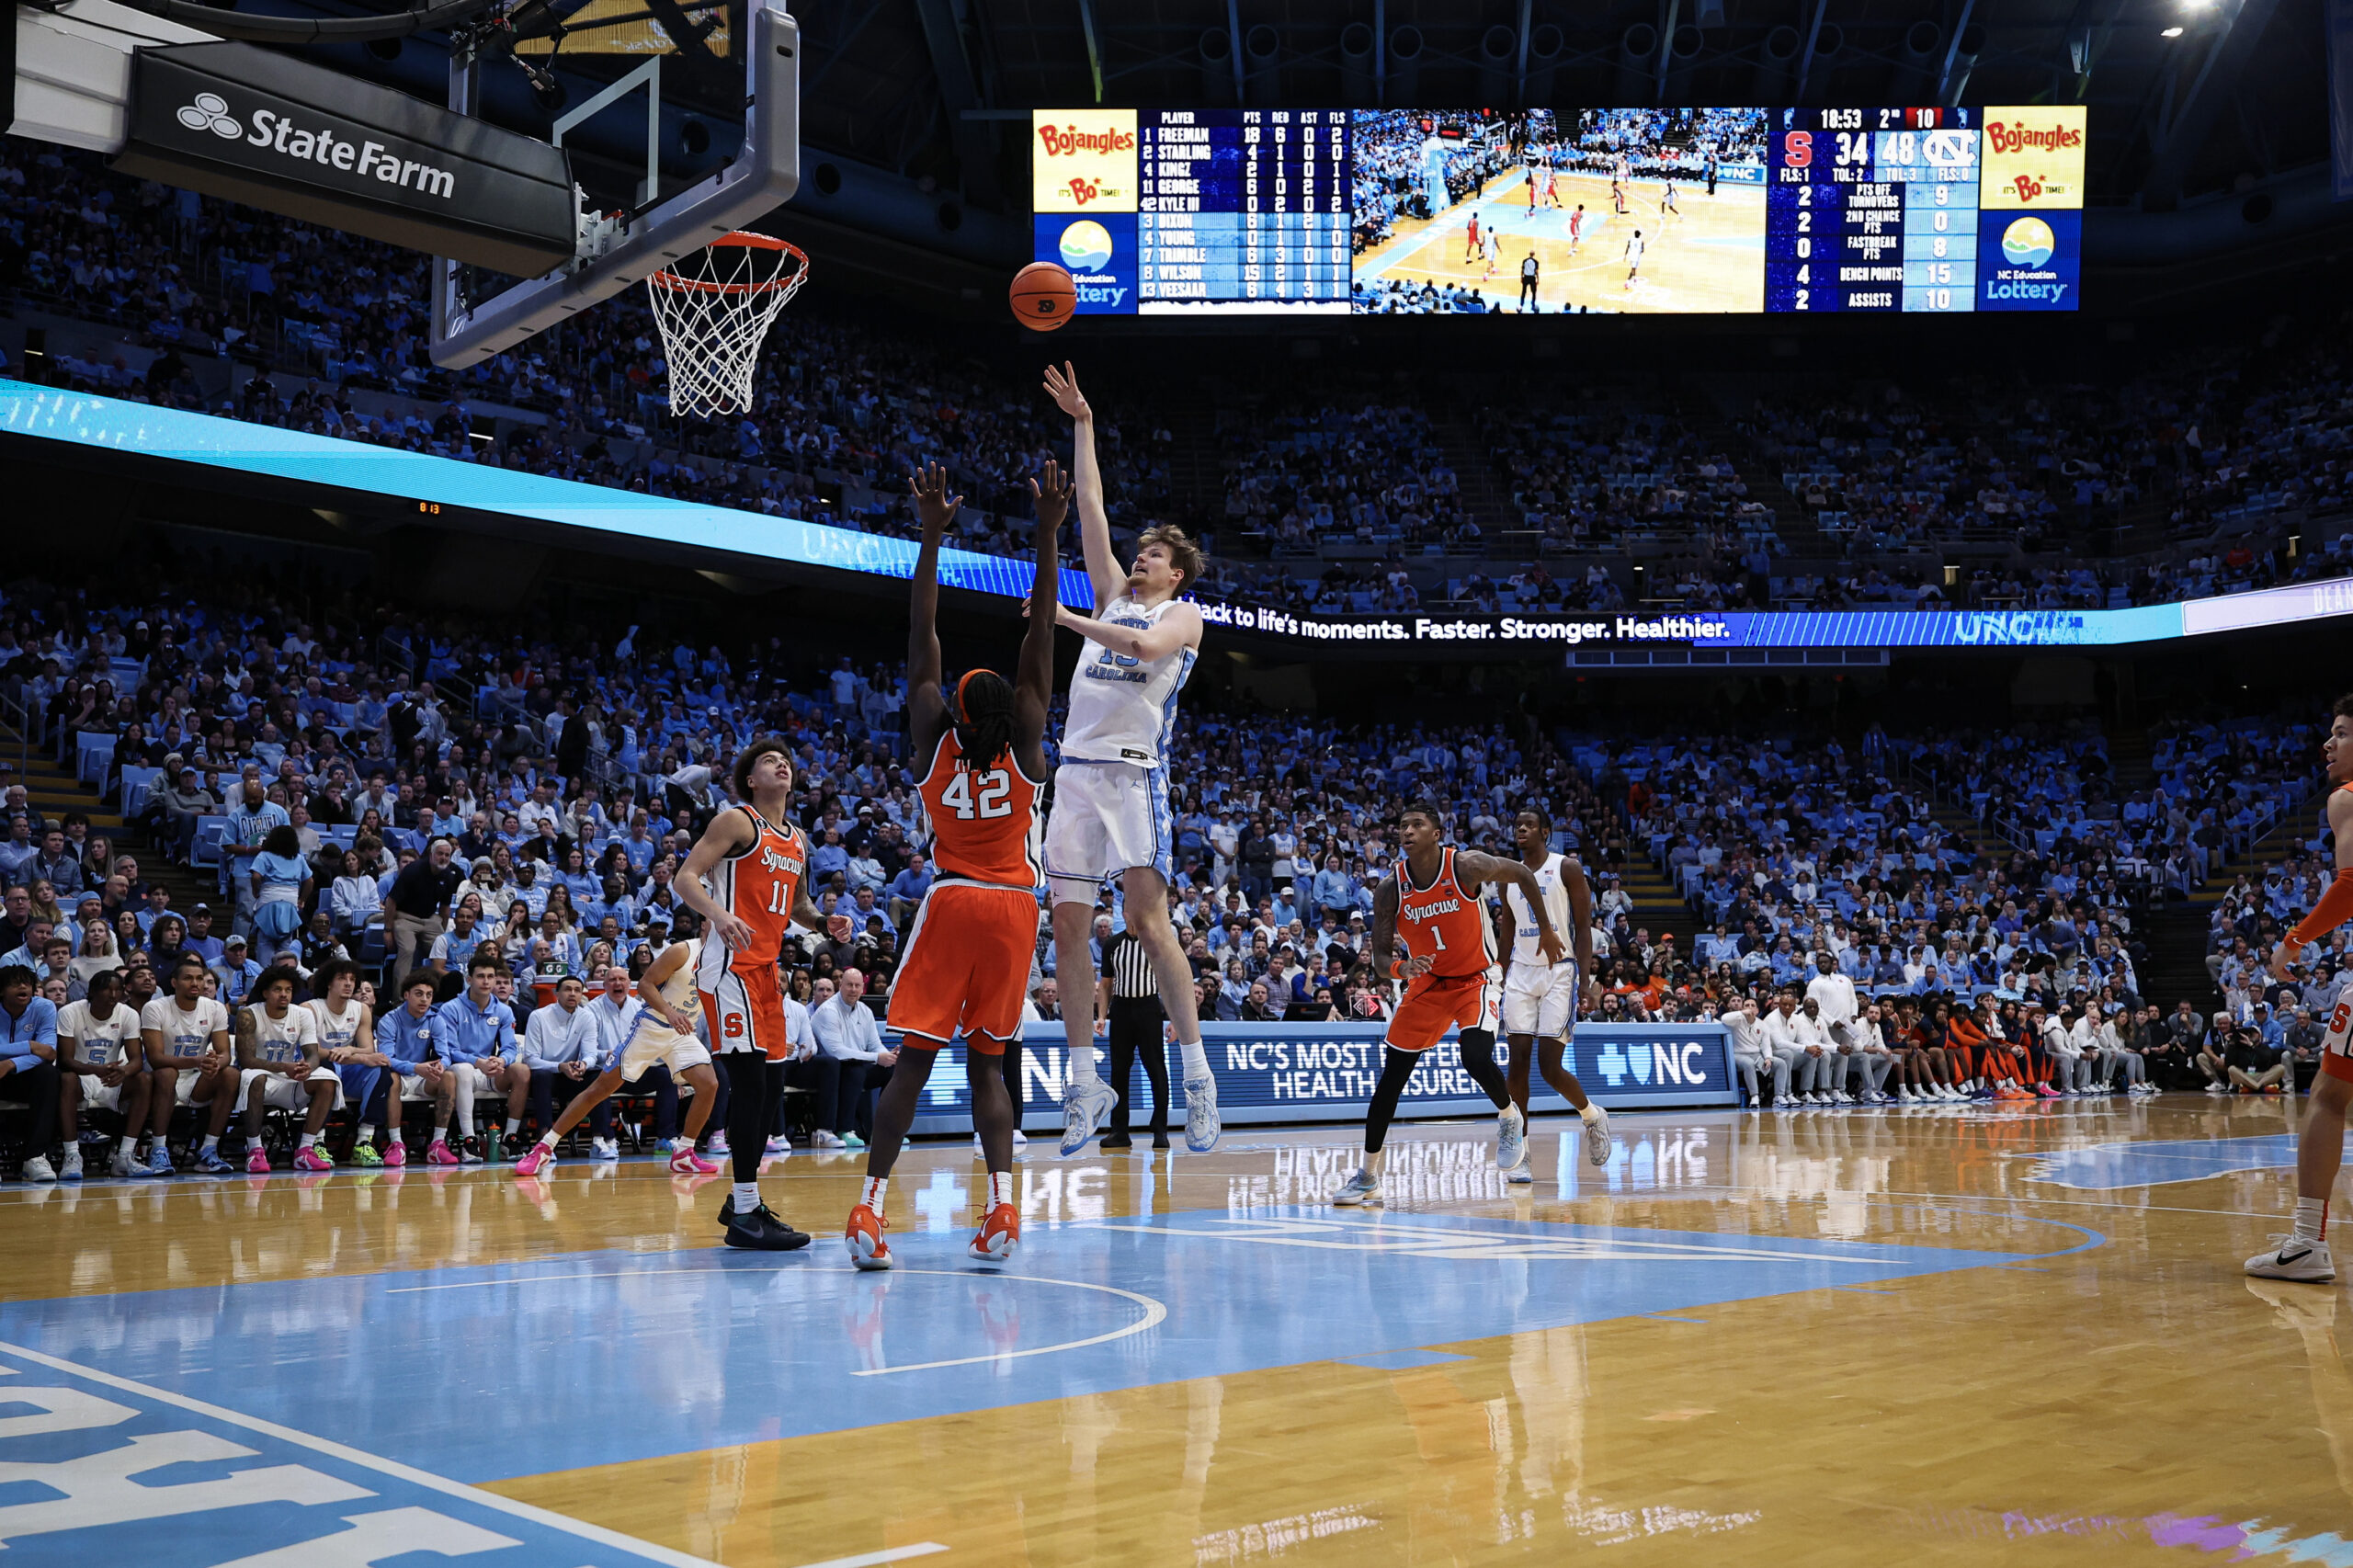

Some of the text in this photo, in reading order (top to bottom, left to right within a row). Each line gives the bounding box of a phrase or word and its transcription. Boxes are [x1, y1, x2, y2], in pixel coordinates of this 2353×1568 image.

[1162, 111, 1195, 124] PLAYER
[1244, 111, 1261, 124] PTS
[1272, 111, 1290, 124] REB
[1301, 111, 1318, 124] AST
[1329, 111, 1346, 124] FLS
[1821, 108, 1862, 129] 18:53
[1916, 108, 1934, 129] 10
[1038, 124, 1134, 156] Bojangles
[1144, 127, 1342, 143] 1 FREEMAN 18 6 0 2
[1985, 121, 2081, 154] Bojangles
[247, 109, 456, 199] State Farm
[1142, 144, 1342, 161] 2 STARLING 4 1 0 0
[1785, 131, 1813, 167] S
[1836, 131, 1869, 165] 34
[1881, 131, 1915, 165] 48
[1144, 161, 1340, 177] 4 KINGZ 2 1 0 1
[1780, 168, 1809, 182] FLS: 1
[1833, 168, 1864, 182] TOL: 2
[1886, 167, 1916, 182] TOL: 3
[1938, 167, 1969, 182] FLS: 0
[1142, 178, 1340, 195] 11 GEORGE 6 0 2 1
[1857, 184, 1892, 196] PTS OFF
[1140, 197, 1157, 211] 42
[1158, 197, 1186, 211] KYLE
[1247, 196, 1258, 212] 0
[1275, 196, 1286, 212] 2
[1303, 196, 1314, 212] 0
[1331, 196, 1342, 212] 2
[1798, 185, 1813, 207] 2
[1848, 196, 1899, 208] TURNOVERS
[1935, 185, 1949, 206] 9
[1143, 212, 1340, 229] 3 DIXON 6 1 2 1
[1798, 211, 1812, 233] 2
[1846, 210, 1864, 222] 2ND
[1934, 211, 1948, 232] 0
[1864, 222, 1881, 234] PTS
[1144, 230, 1342, 246] 4 YOUNG 0 1 1 0
[1847, 236, 1897, 248] FASTBREAK
[1144, 246, 1342, 263] 7 TRIMBLE 6 3 0 0
[1797, 238, 1811, 258] 0
[1863, 248, 1881, 260] PTS
[1933, 237, 1947, 257] 8
[1072, 273, 1117, 283] Education
[1143, 264, 1340, 280] 8 WILSON 15 2 1 1
[1796, 264, 1810, 285] 4
[1840, 267, 1904, 281] BENCH POINTS
[1927, 264, 1951, 284] 15
[1997, 270, 2057, 279] NC Education
[1076, 284, 1127, 307] tery
[1142, 281, 1340, 298] 13 VEESAAR 6 4 3 1
[1987, 280, 2066, 303] Lottery
[1795, 289, 1809, 310] 2
[1848, 293, 1893, 307] ASSISTS
[1927, 289, 1950, 309] 10
[1234, 607, 1255, 627] to
[1257, 608, 1298, 634] life's
[1302, 619, 1410, 640] moments.
[1415, 619, 1495, 640] Faster.
[1500, 617, 1611, 644] Stronger.
[1616, 617, 1731, 639] Healthier.
[1086, 665, 1147, 683] CAROLINA
[940, 768, 1013, 819] 42
[767, 880, 789, 916] 11
[1404, 898, 1461, 925] Syracuse
[1430, 926, 1446, 950] 1
[724, 1013, 744, 1038] S
[2329, 1003, 2351, 1033] S
[85, 1040, 114, 1048] NORTH
[175, 1035, 204, 1044] NORTH
[1226, 1042, 1290, 1071] NC'S
[1297, 1042, 1371, 1069] MOST
[1653, 1042, 1707, 1085] NC
[1273, 1071, 1376, 1099] HEALTH
